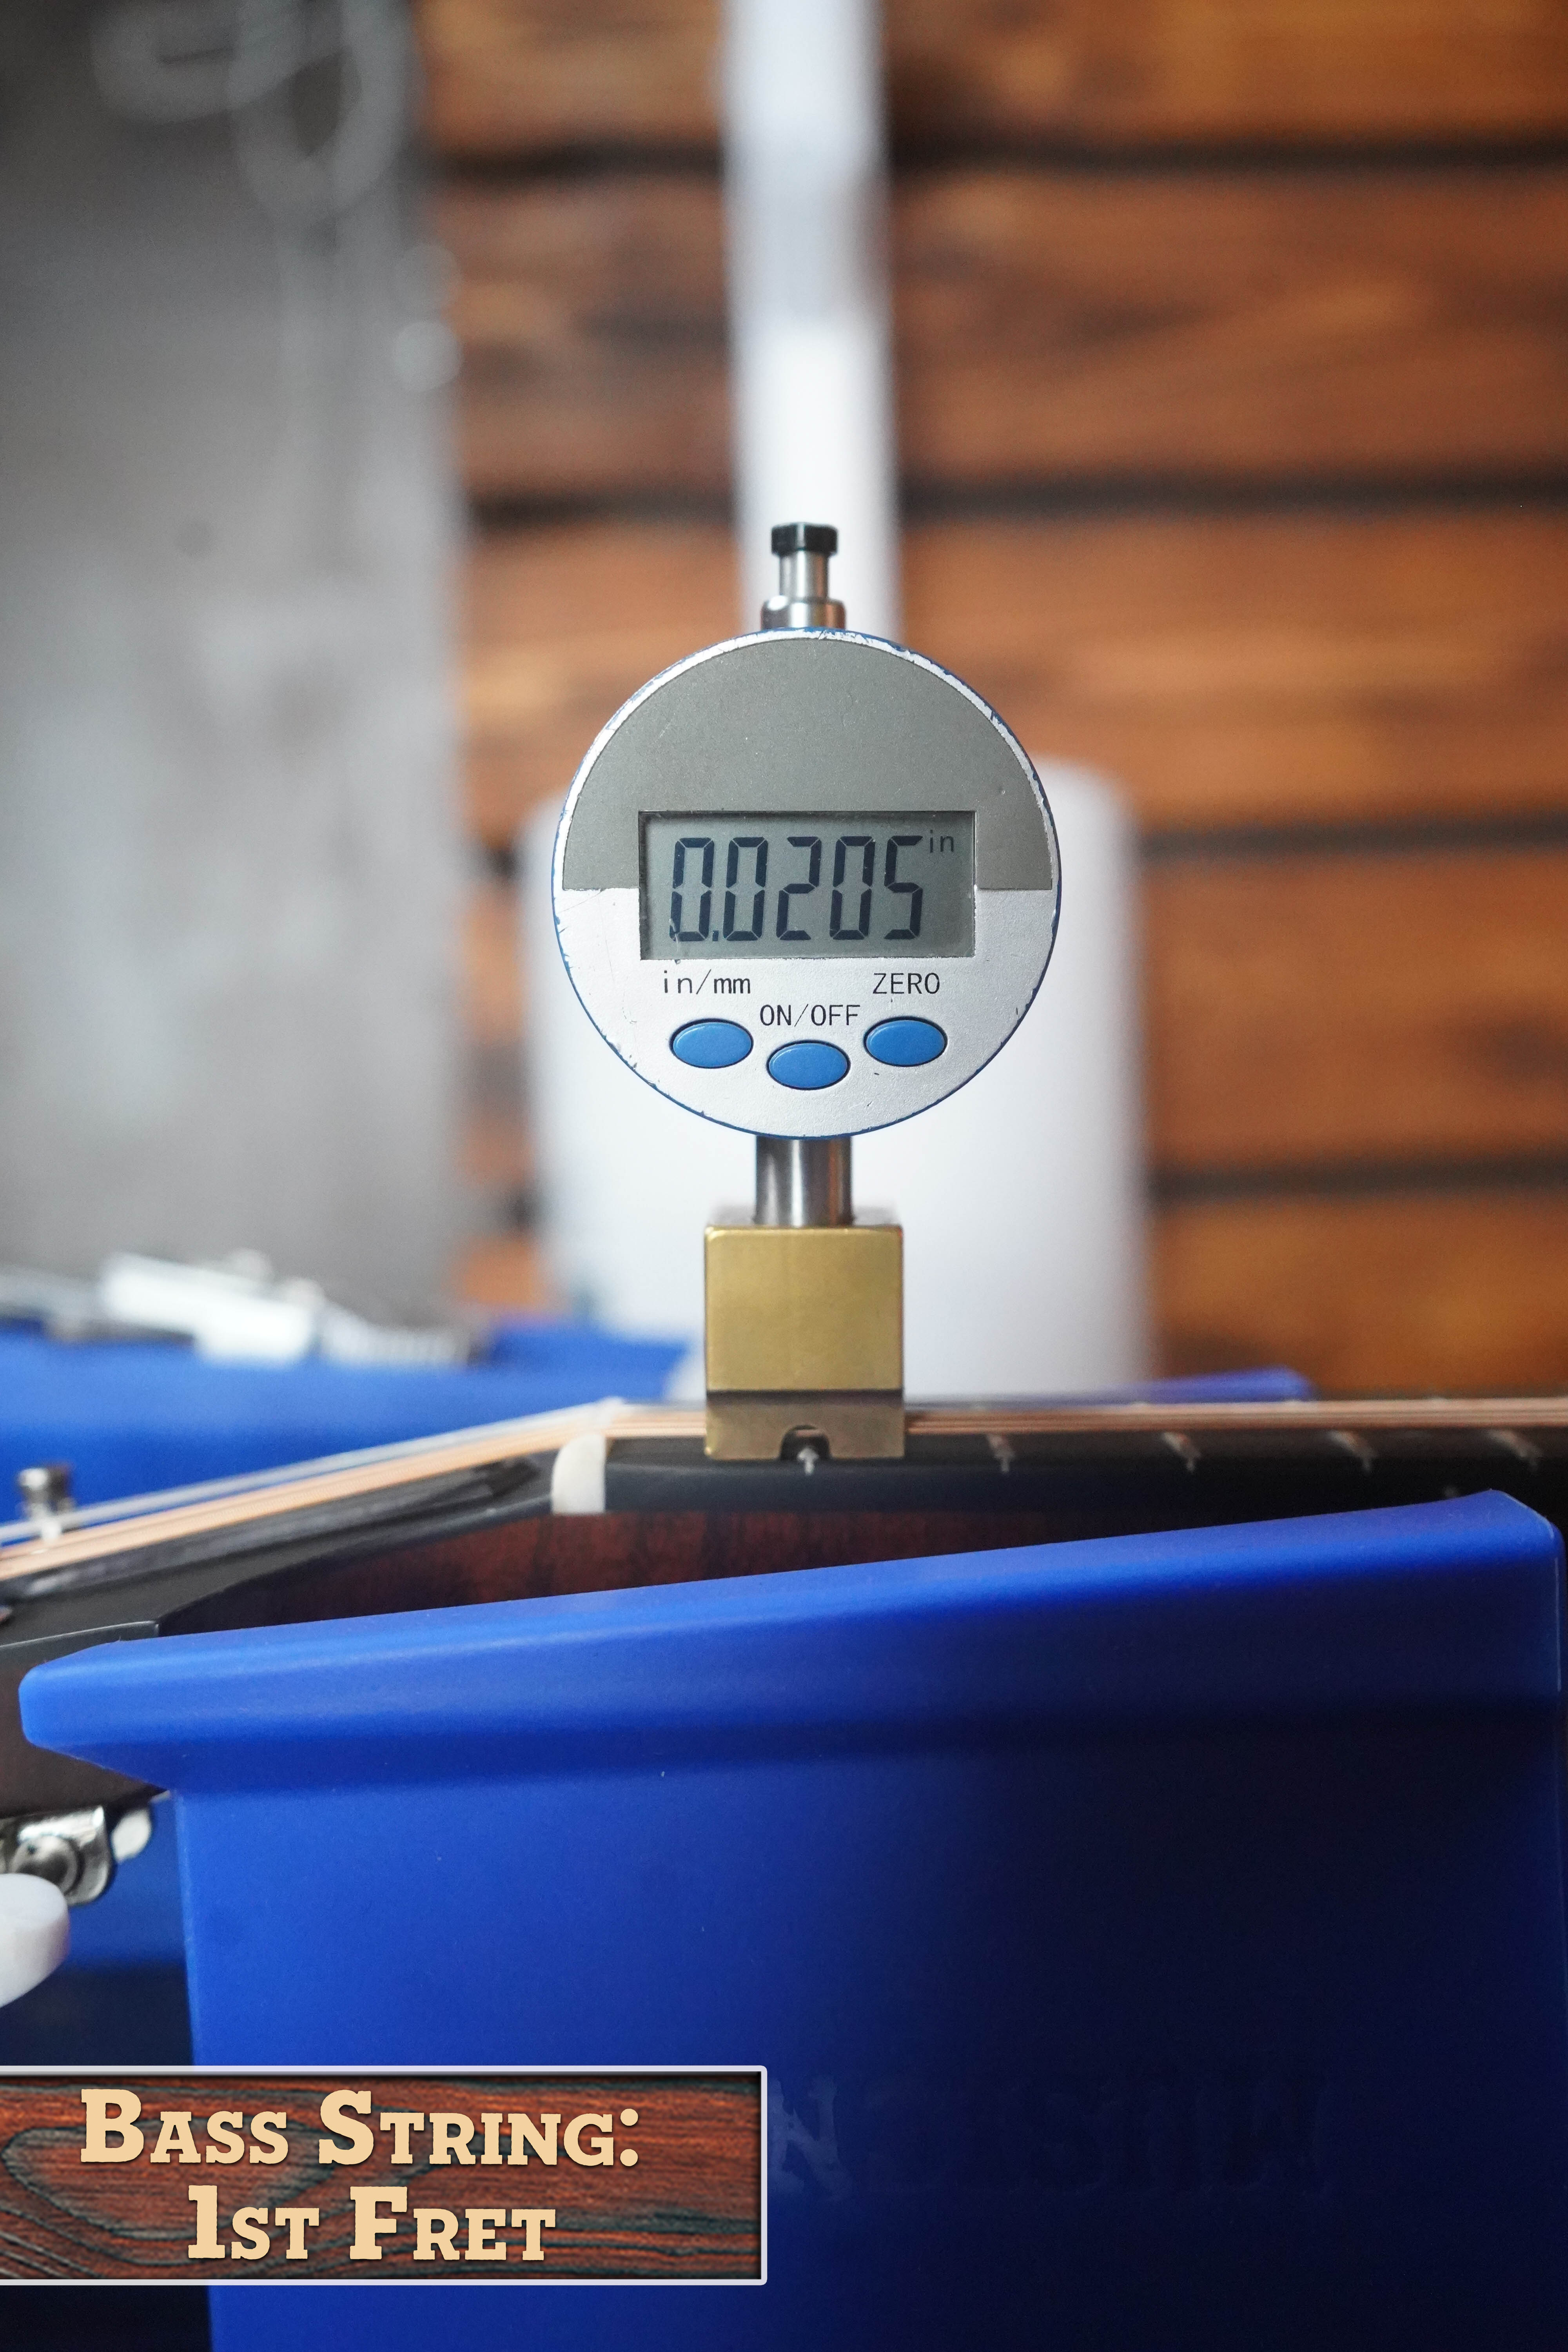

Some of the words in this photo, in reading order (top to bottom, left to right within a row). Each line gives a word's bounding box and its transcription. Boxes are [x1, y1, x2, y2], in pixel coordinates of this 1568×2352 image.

[669, 835, 925, 942] 0.0205
[929, 828, 956, 855] in
[664, 969, 751, 995] in/mm
[872, 972, 940, 995] ZERO
[760, 1004, 861, 1026] ON/OFF
